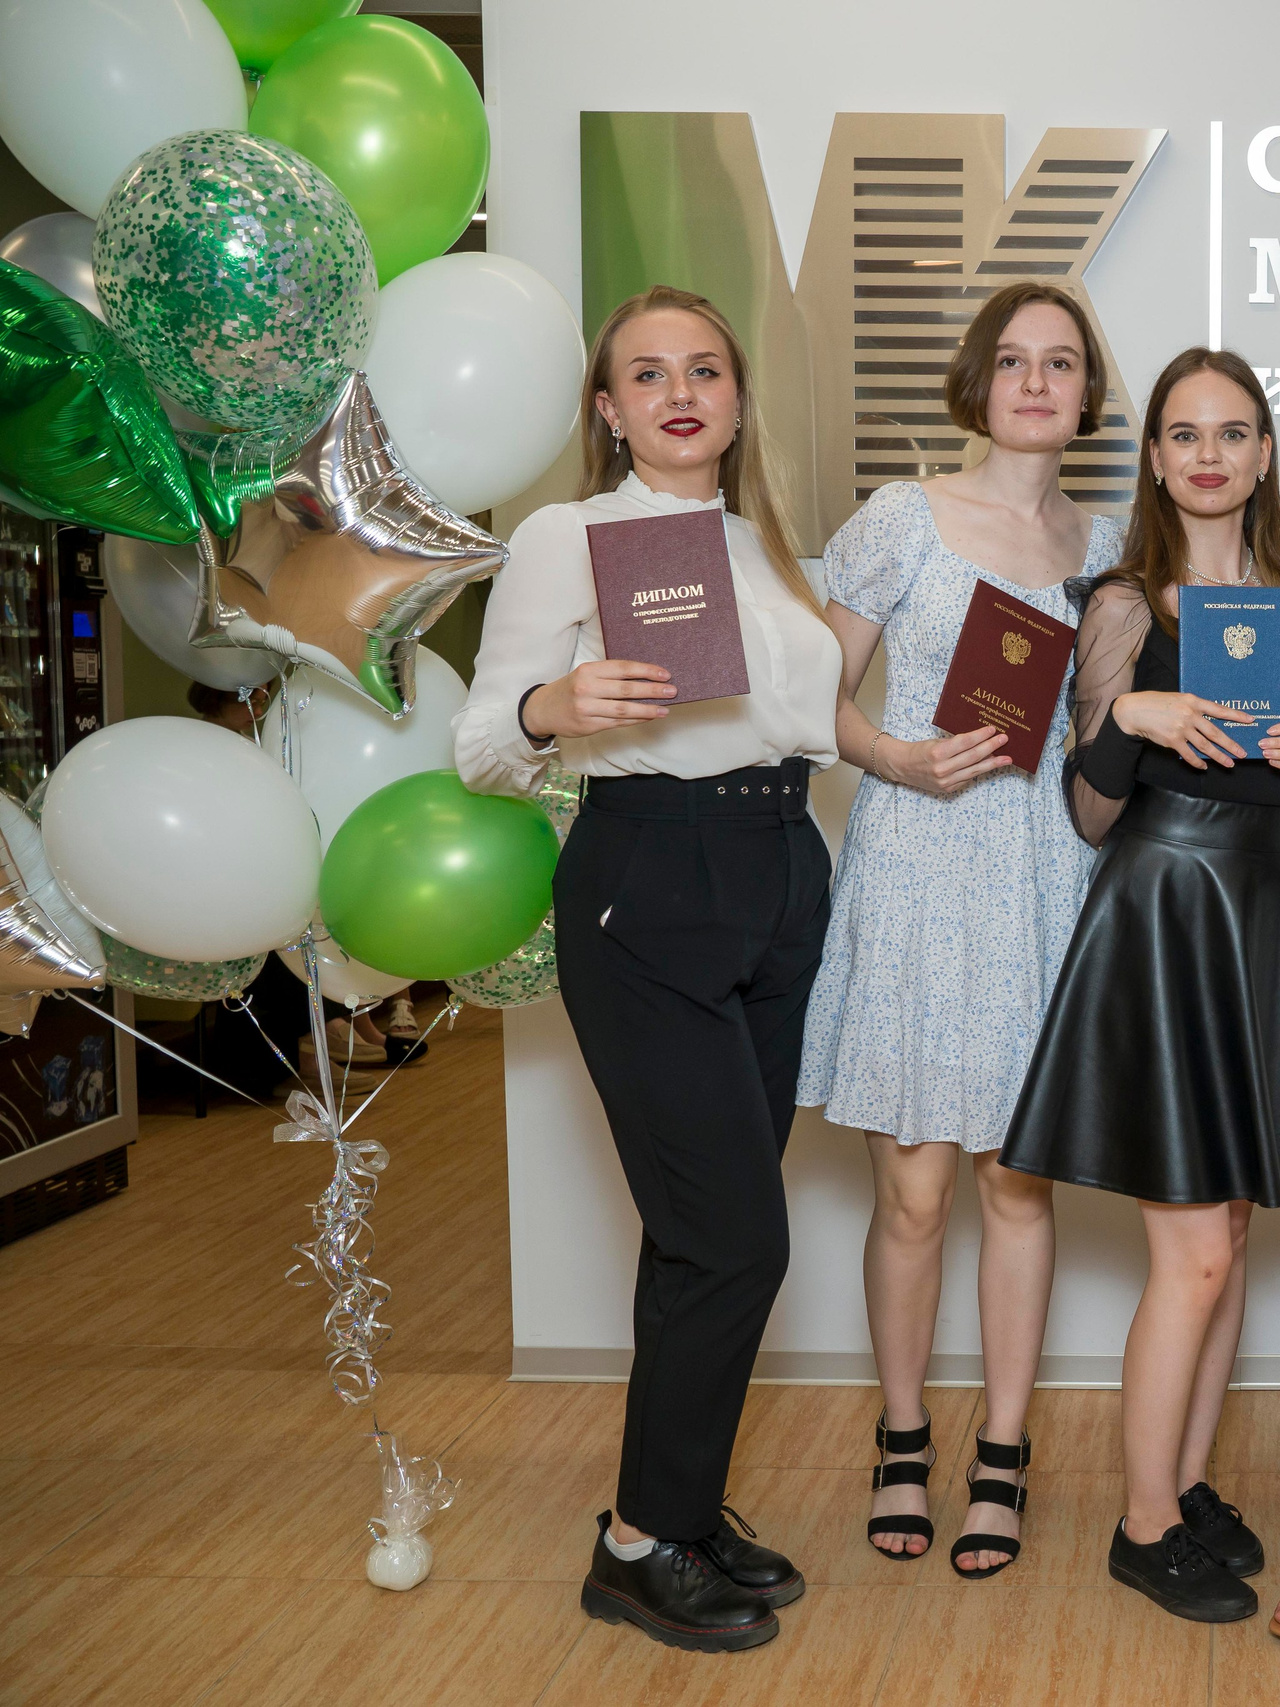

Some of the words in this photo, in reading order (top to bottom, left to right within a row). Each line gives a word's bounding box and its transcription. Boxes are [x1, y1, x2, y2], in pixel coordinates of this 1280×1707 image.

[631, 584, 705, 607] ДИПЛОМ
[639, 602, 707, 617] ПРОФЕССИОНАЛЬНОЙ
[643, 613, 700, 625] ПЕРЕПОДГОТОВКЕ
[973, 687, 1026, 719] ДИПЛОМ
